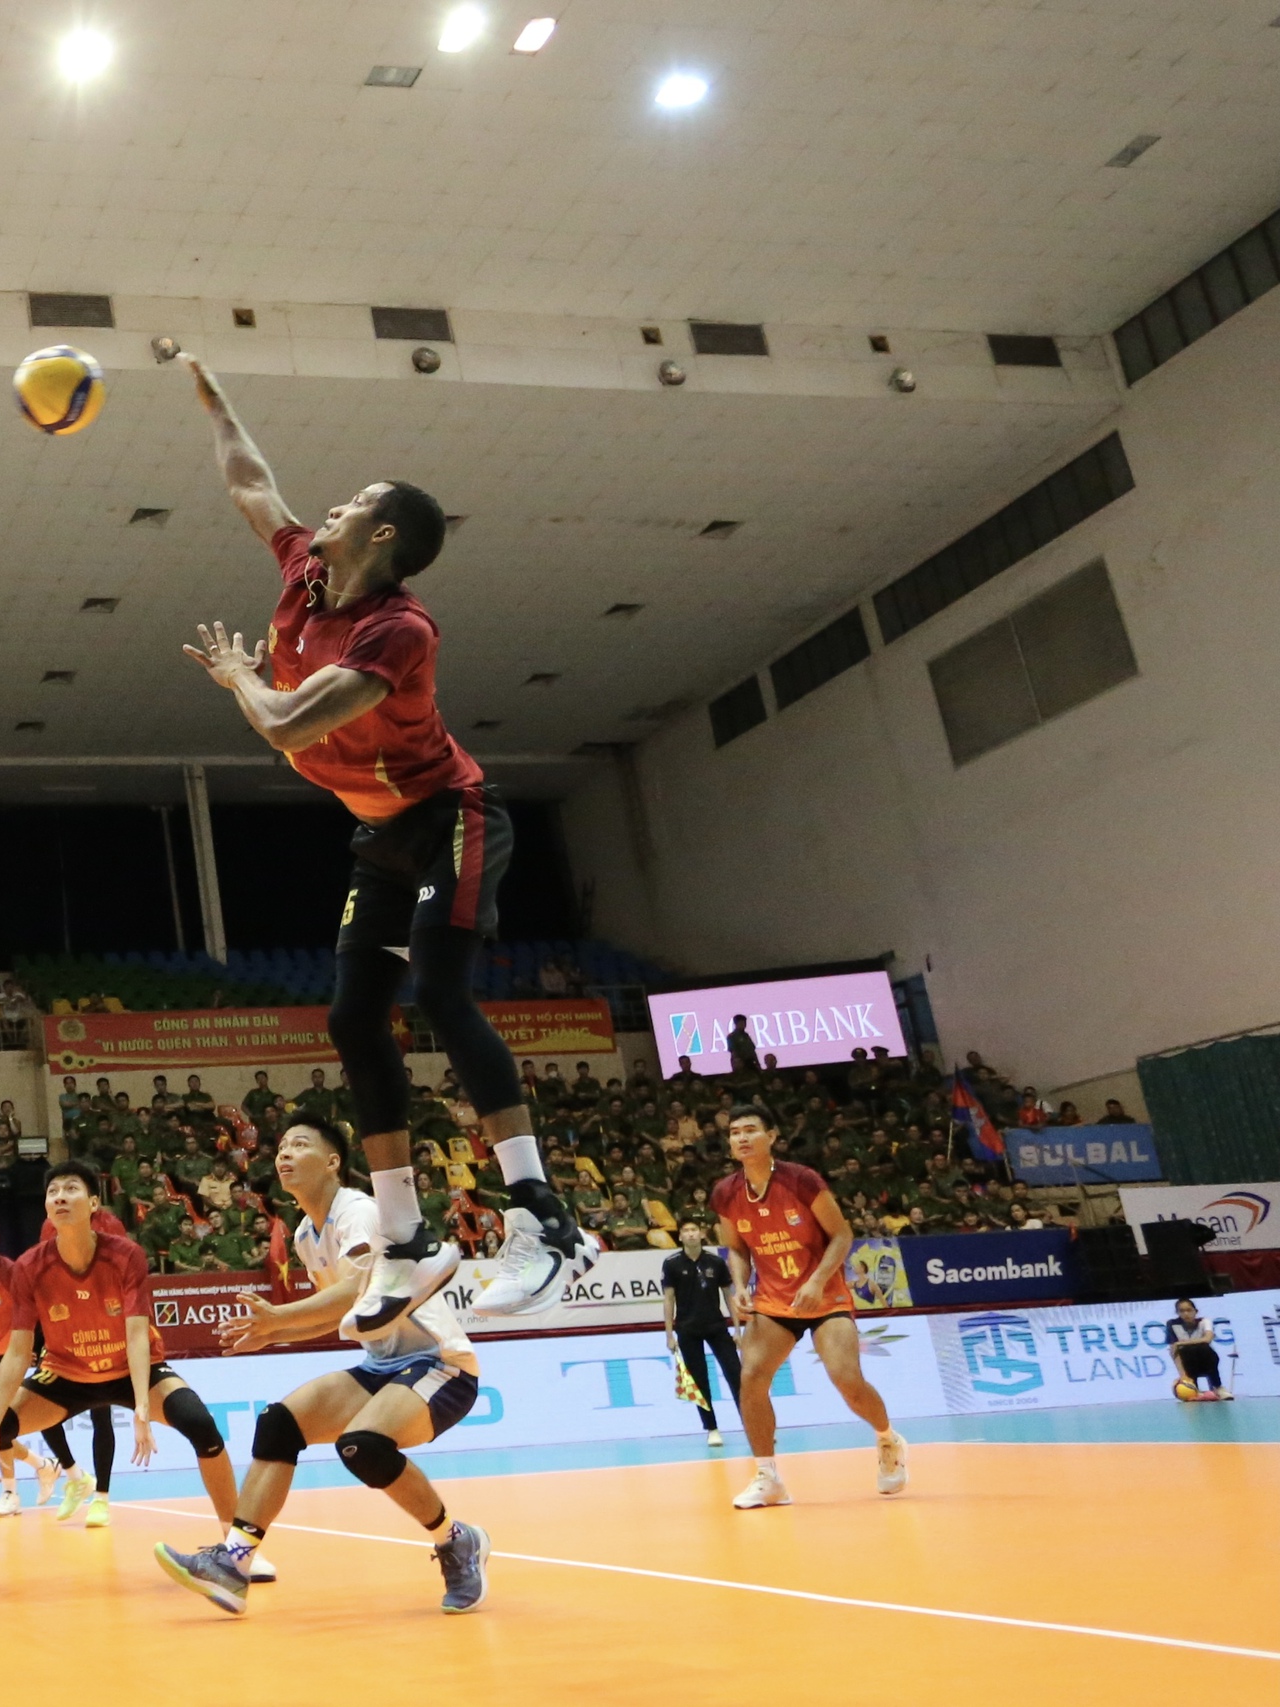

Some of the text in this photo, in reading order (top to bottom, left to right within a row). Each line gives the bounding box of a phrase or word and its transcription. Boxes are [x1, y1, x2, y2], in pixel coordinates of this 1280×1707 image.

[193, 1018, 211, 1029] AN
[710, 1003, 884, 1053] ARIBANK
[777, 1255, 799, 1279] 14
[926, 1254, 1063, 1285] Sacombank
[611, 1281, 626, 1299] A
[630, 1279, 665, 1298] BA
[183, 1304, 253, 1326] AGRI
[98, 1328, 111, 1341] AN
[1046, 1316, 1236, 1352] TRUOG
[88, 1358, 113, 1373] 10
[1064, 1354, 1167, 1383] LAND
